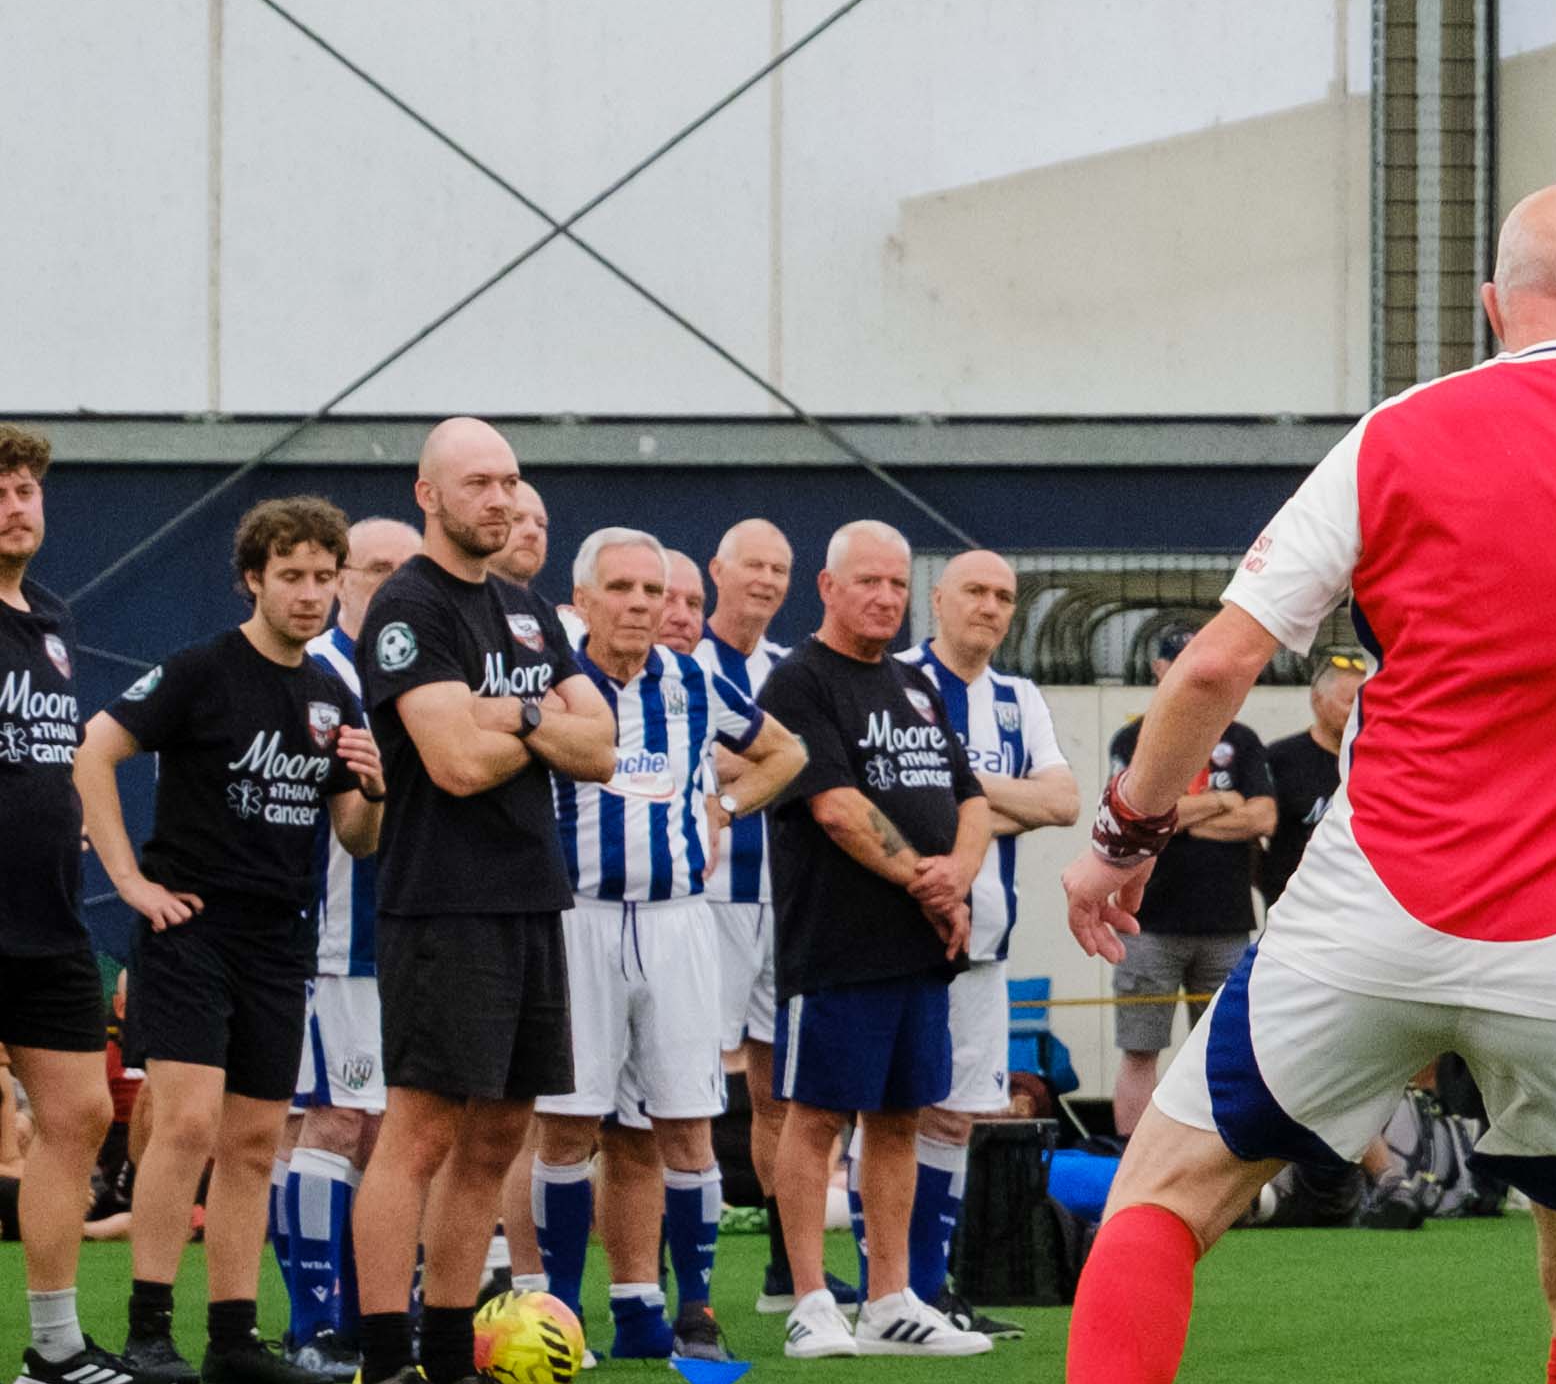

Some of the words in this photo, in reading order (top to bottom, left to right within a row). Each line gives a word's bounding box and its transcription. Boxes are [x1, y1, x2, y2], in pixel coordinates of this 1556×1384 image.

[858, 709, 948, 752] Moore
[228, 730, 330, 782] Moore
[900, 769, 952, 788] cancer
[264, 803, 320, 825] cancer
